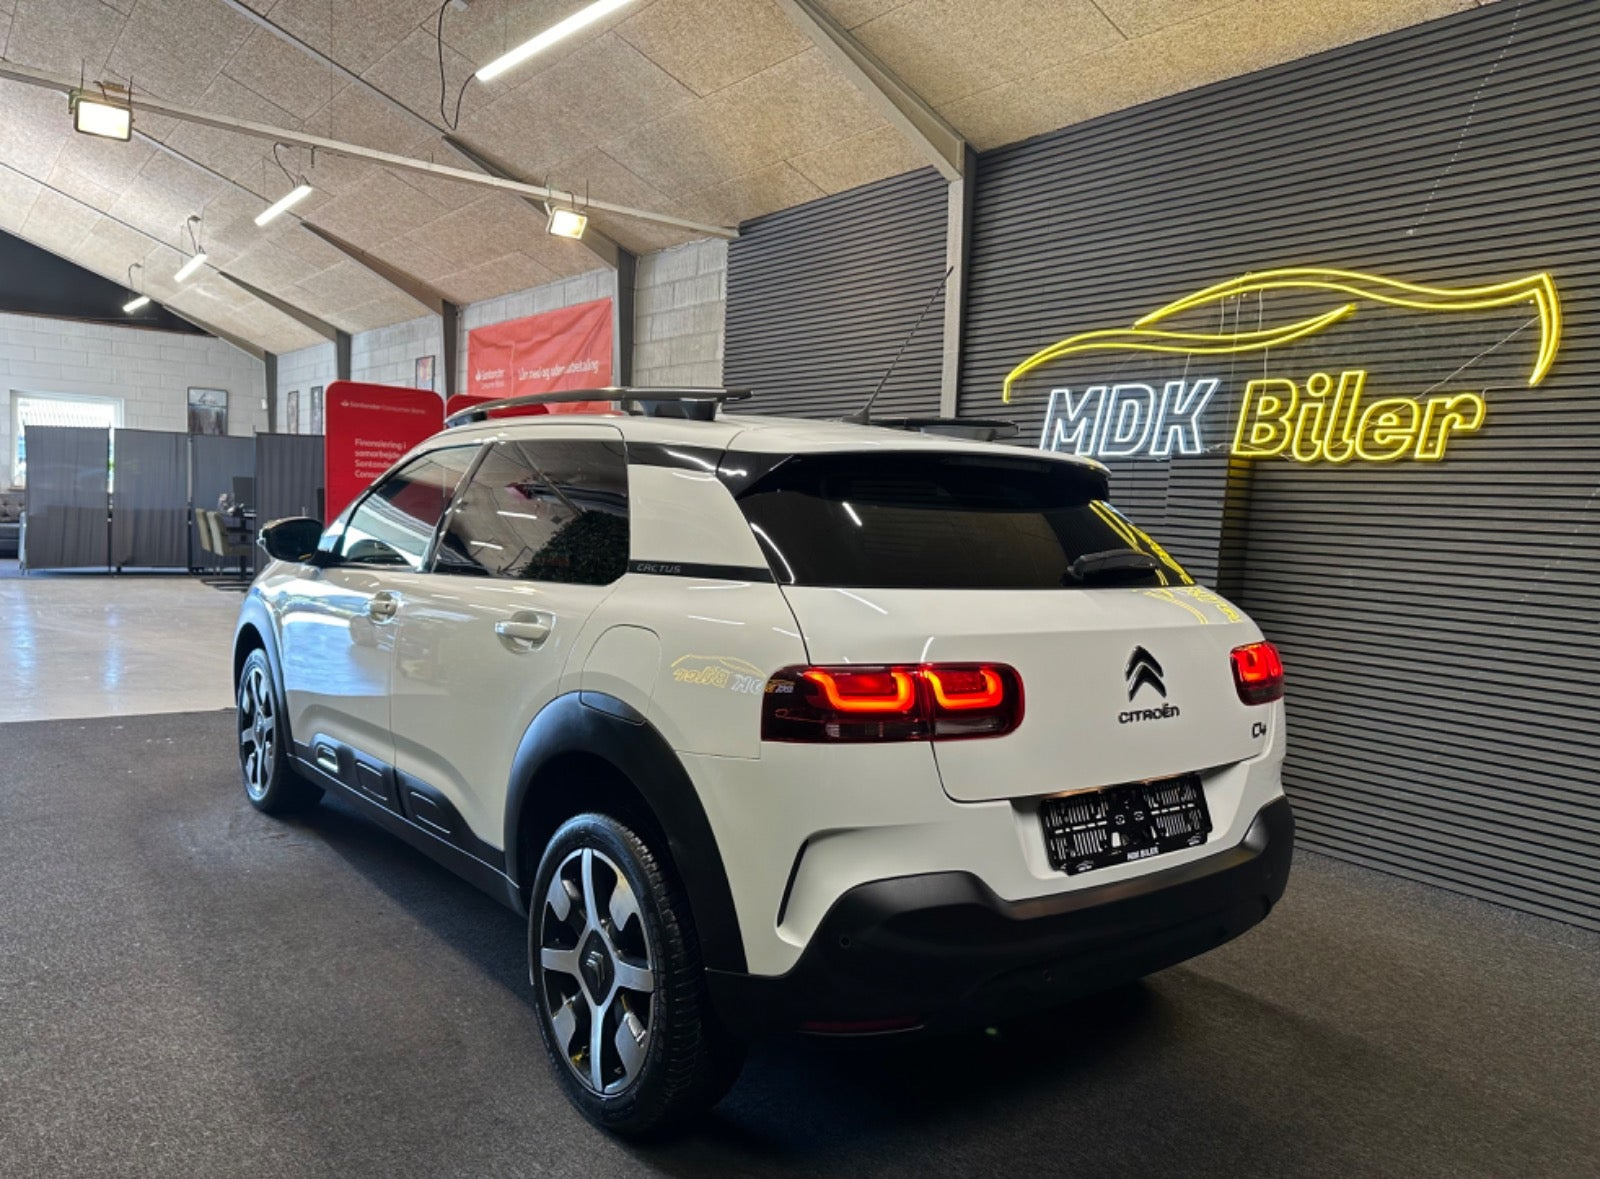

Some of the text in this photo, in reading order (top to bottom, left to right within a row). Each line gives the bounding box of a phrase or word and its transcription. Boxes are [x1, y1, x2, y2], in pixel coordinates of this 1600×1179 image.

[1039, 369, 1486, 464] MDK Biler
[354, 459, 393, 469] Santande
[636, 563, 681, 574] CACTUS
[1252, 721, 1267, 739] C4
